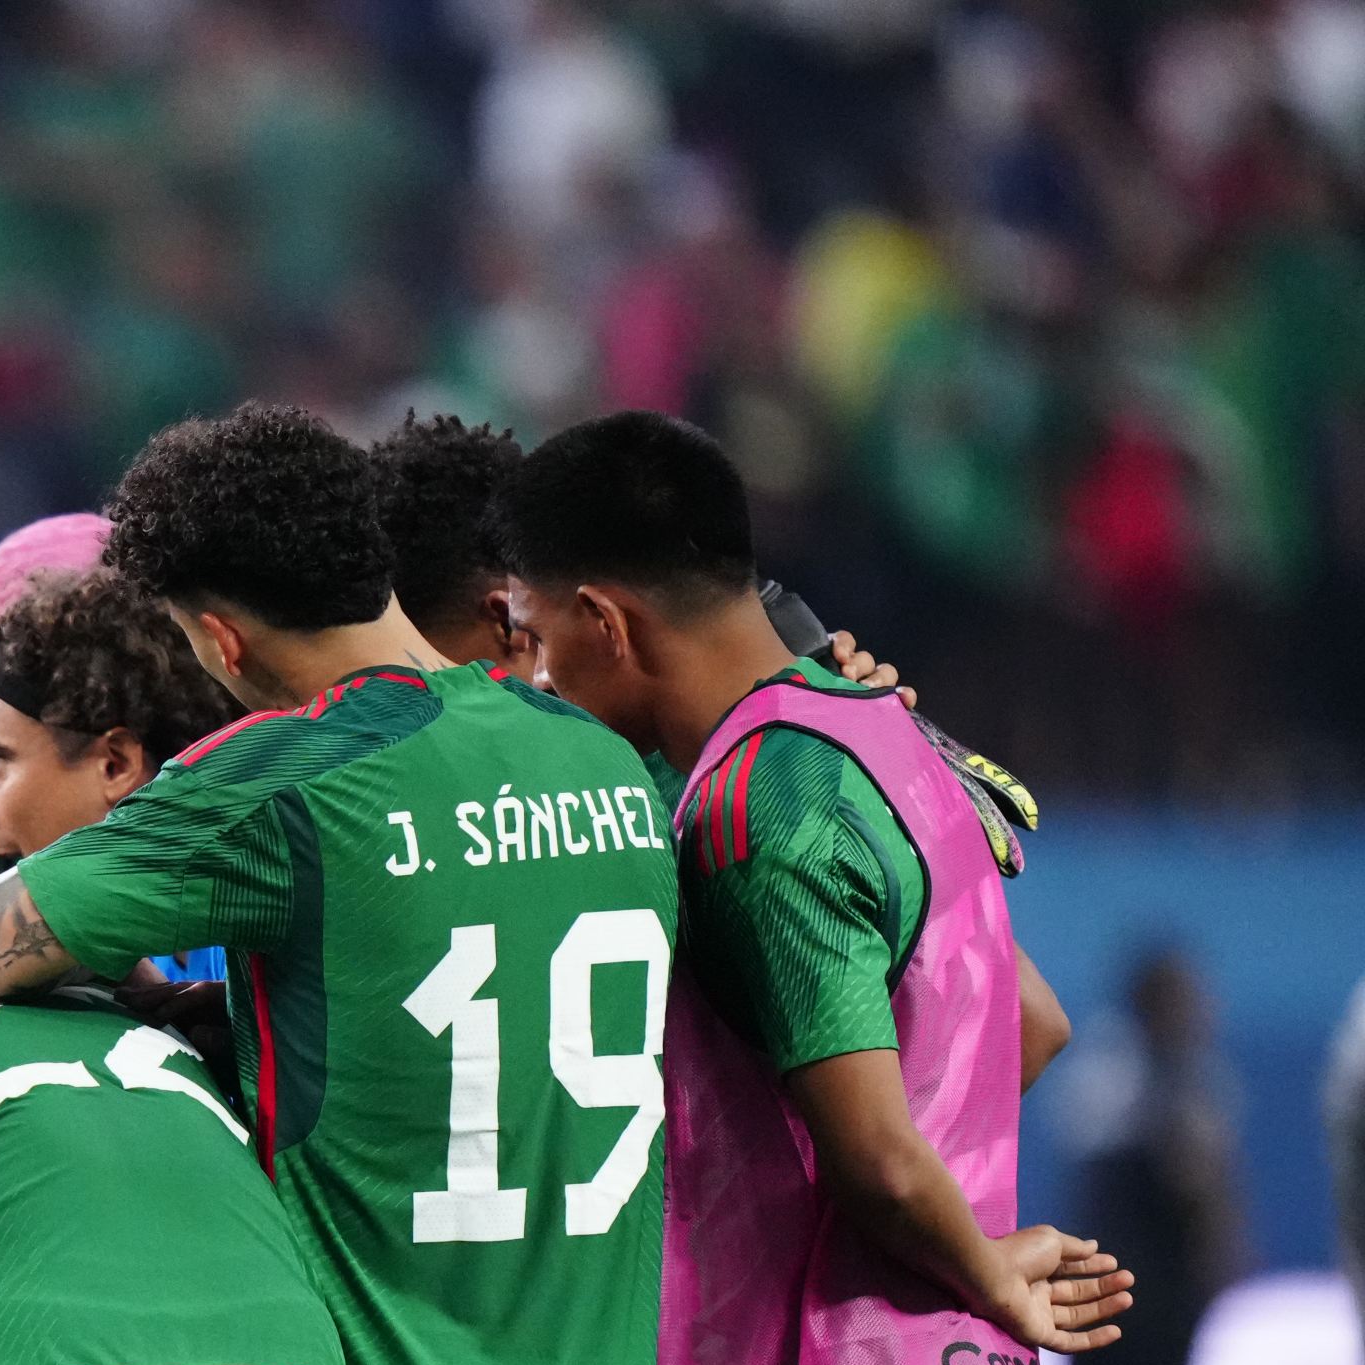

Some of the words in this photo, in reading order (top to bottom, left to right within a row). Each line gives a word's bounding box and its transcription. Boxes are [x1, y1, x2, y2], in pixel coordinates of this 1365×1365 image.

[385, 810, 436, 876] J.
[455, 784, 665, 866] SÁNCHEZ
[402, 908, 671, 1243] 19
